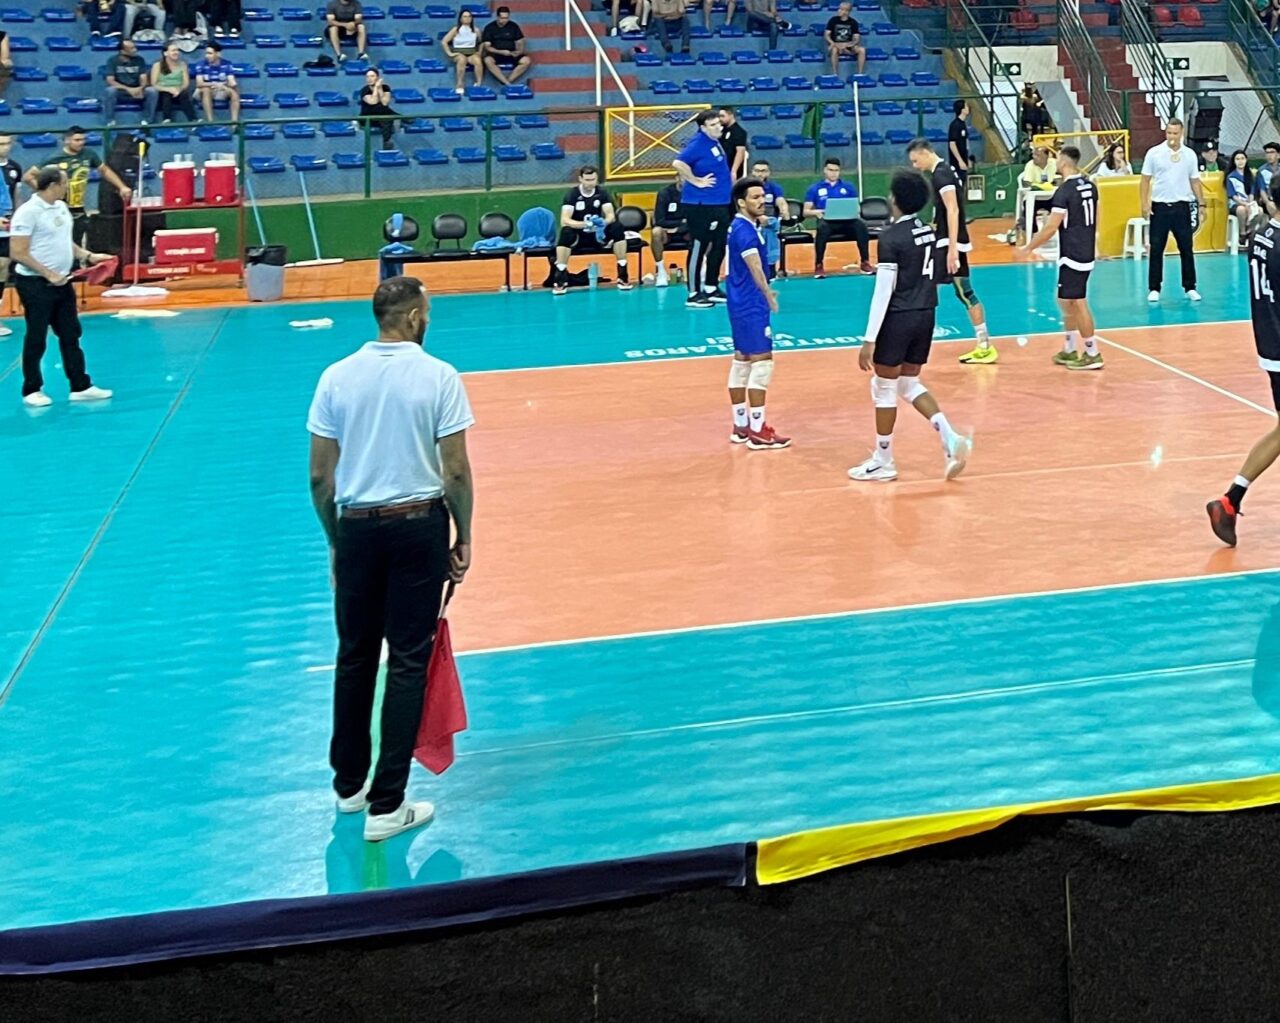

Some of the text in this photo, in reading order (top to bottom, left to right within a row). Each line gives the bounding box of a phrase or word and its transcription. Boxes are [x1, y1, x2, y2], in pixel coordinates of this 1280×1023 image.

[1082, 198, 1094, 226] 11
[922, 245, 935, 281] 4
[1250, 258, 1275, 304] 14
